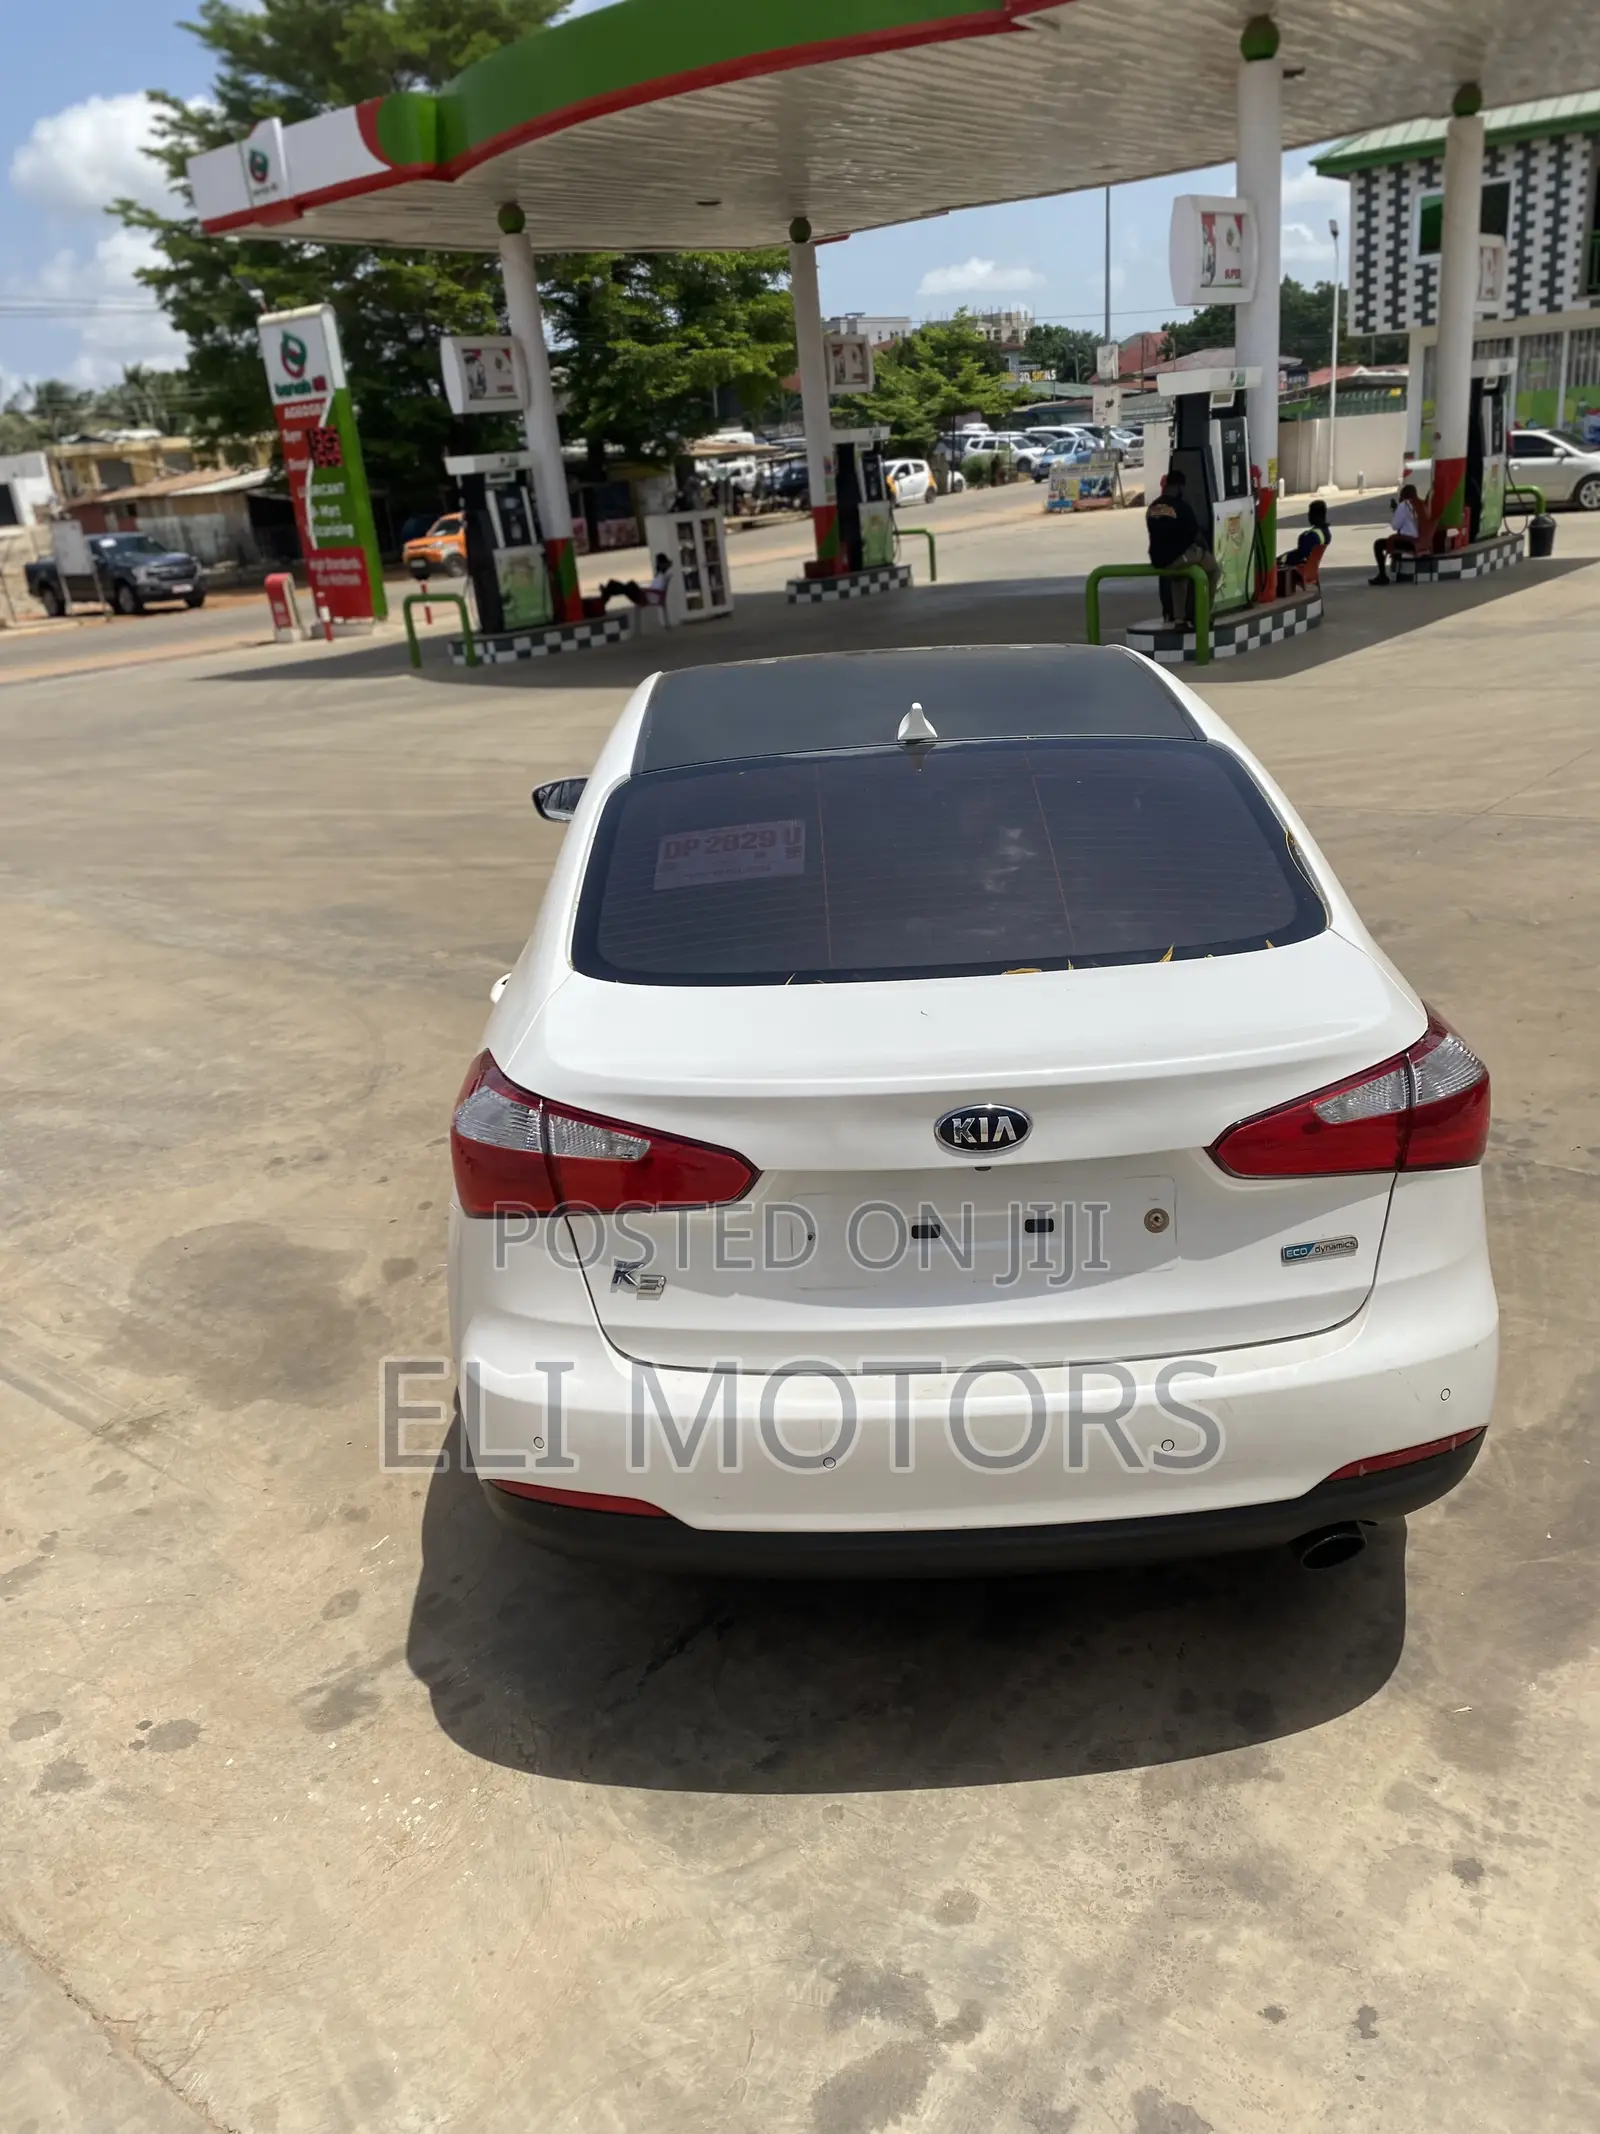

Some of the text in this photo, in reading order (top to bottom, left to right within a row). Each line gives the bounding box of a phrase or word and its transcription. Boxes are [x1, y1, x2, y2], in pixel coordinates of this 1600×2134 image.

[952, 1116, 1017, 1143] KIA
[1286, 1239, 1356, 1258] ECO dynamics
[611, 1259, 667, 1297] K3
